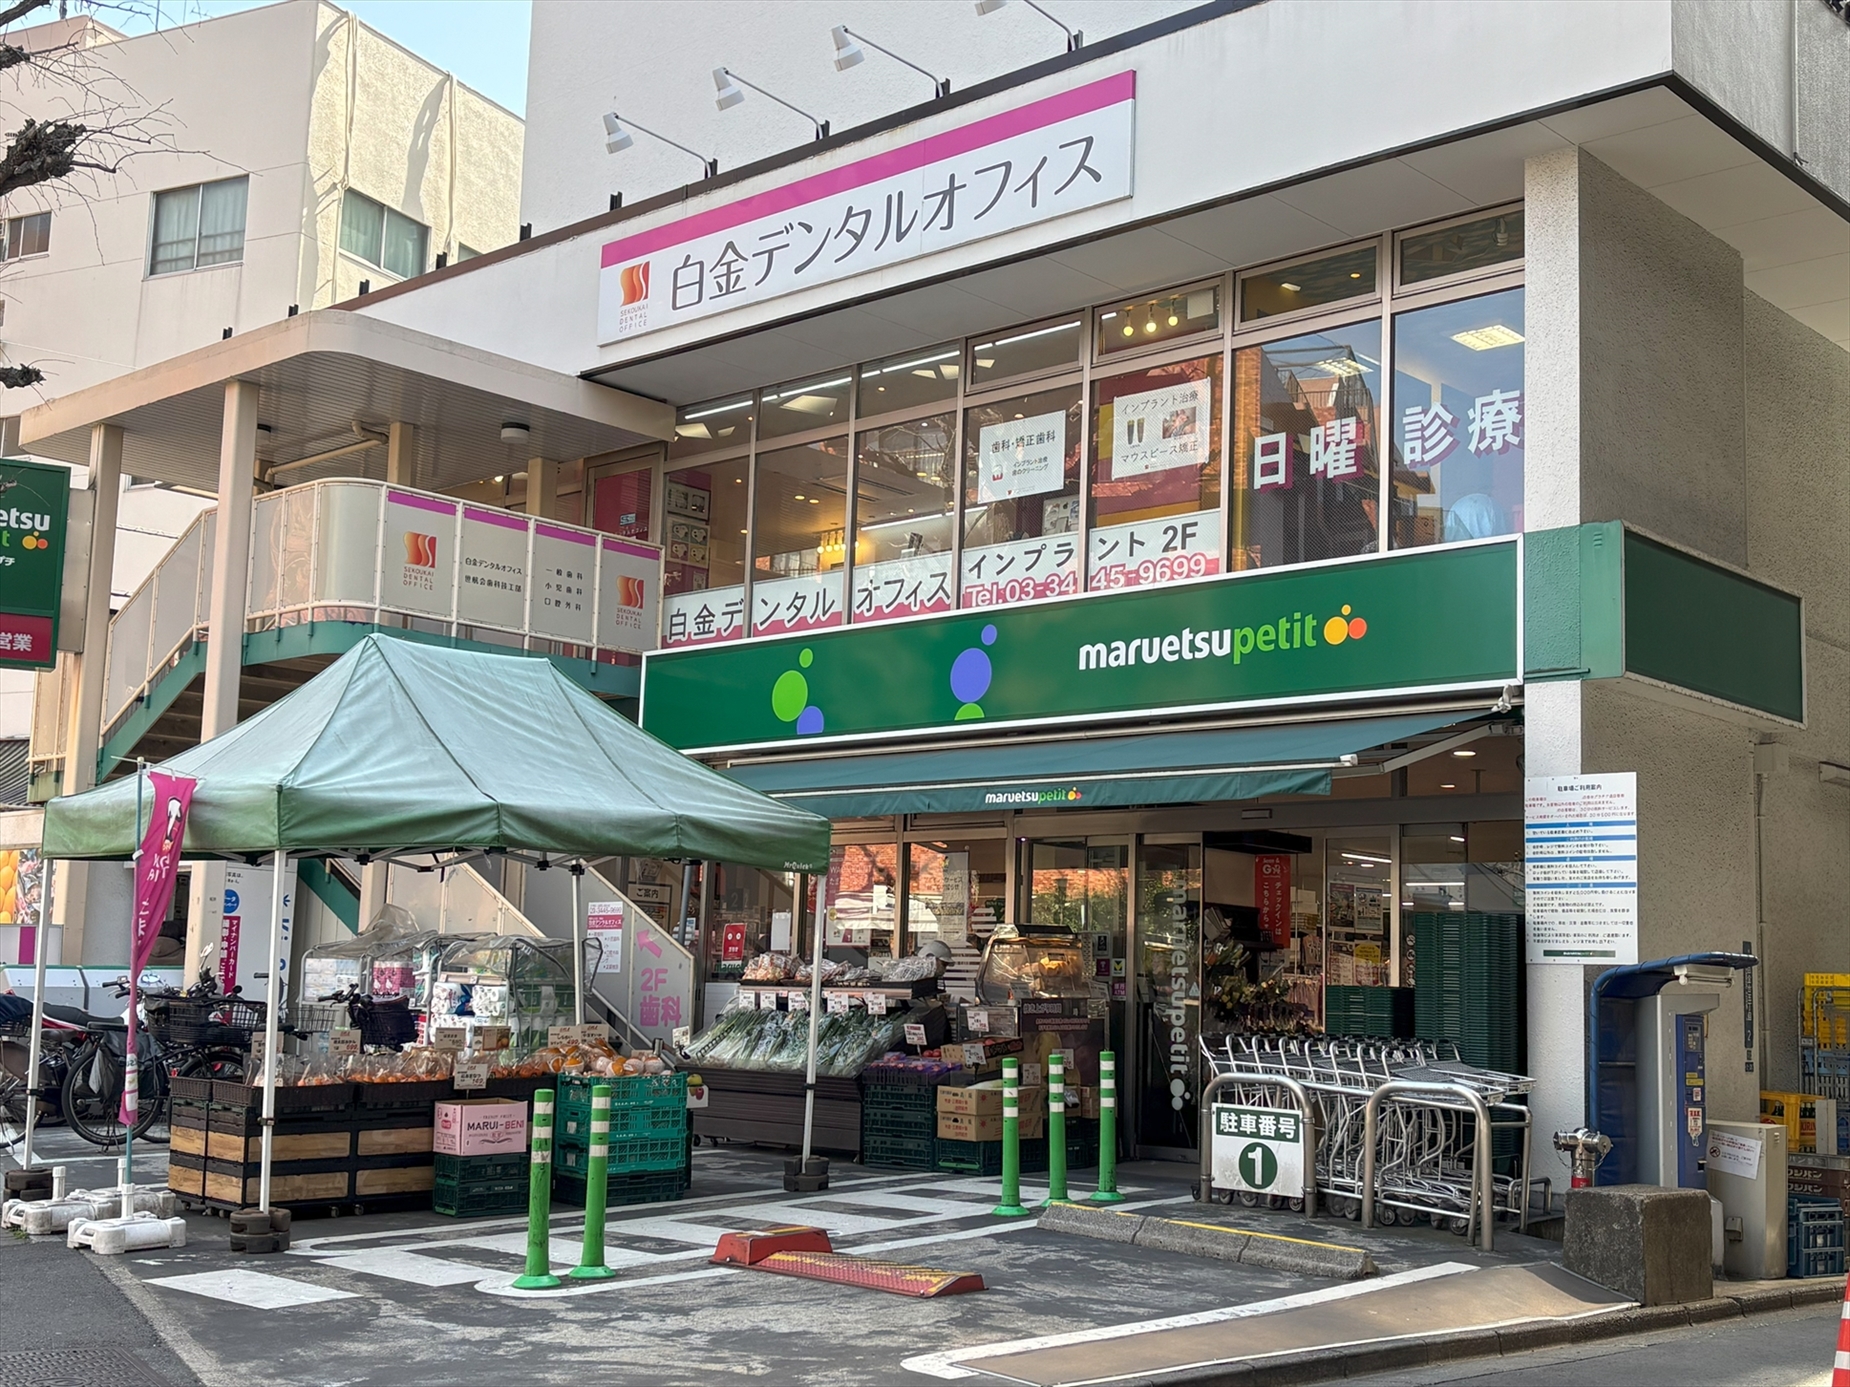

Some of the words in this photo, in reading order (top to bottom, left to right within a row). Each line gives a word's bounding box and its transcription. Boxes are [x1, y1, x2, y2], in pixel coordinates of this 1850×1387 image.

[670, 135, 1103, 312] 白金デンタルオフィス
[619, 319, 647, 332] OFFICE
[620, 312, 647, 325] DENTAL
[1122, 390, 1199, 414] インプラント治療
[991, 430, 1056, 453] 歯科・矯正歯科
[1253, 389, 1524, 490] 日曜診療
[968, 530, 1145, 579] インプラント
[1161, 522, 1199, 552] 2F
[404, 566, 434, 577] SEKOUKAI
[465, 557, 522, 575] 白金デンタルオフィス
[403, 580, 433, 590] OFFICE
[404, 573, 433, 584] DENTAL
[545, 582, 583, 595] 小児歯科
[616, 613, 641, 623] DENTAL
[616, 619, 641, 629] OFFICE
[1557, 784, 1602, 792] 駐車場ご利用案内
[636, 888, 659, 898] ご案内
[228, 919, 238, 978] マイナンバーカード
[641, 966, 668, 992] 2F
[639, 995, 682, 1028] 歯科
[467, 1119, 525, 1131] MARUI-BENI
[1219, 1112, 1297, 1139] 駐車番号
[1248, 1147, 1263, 1186] 1
